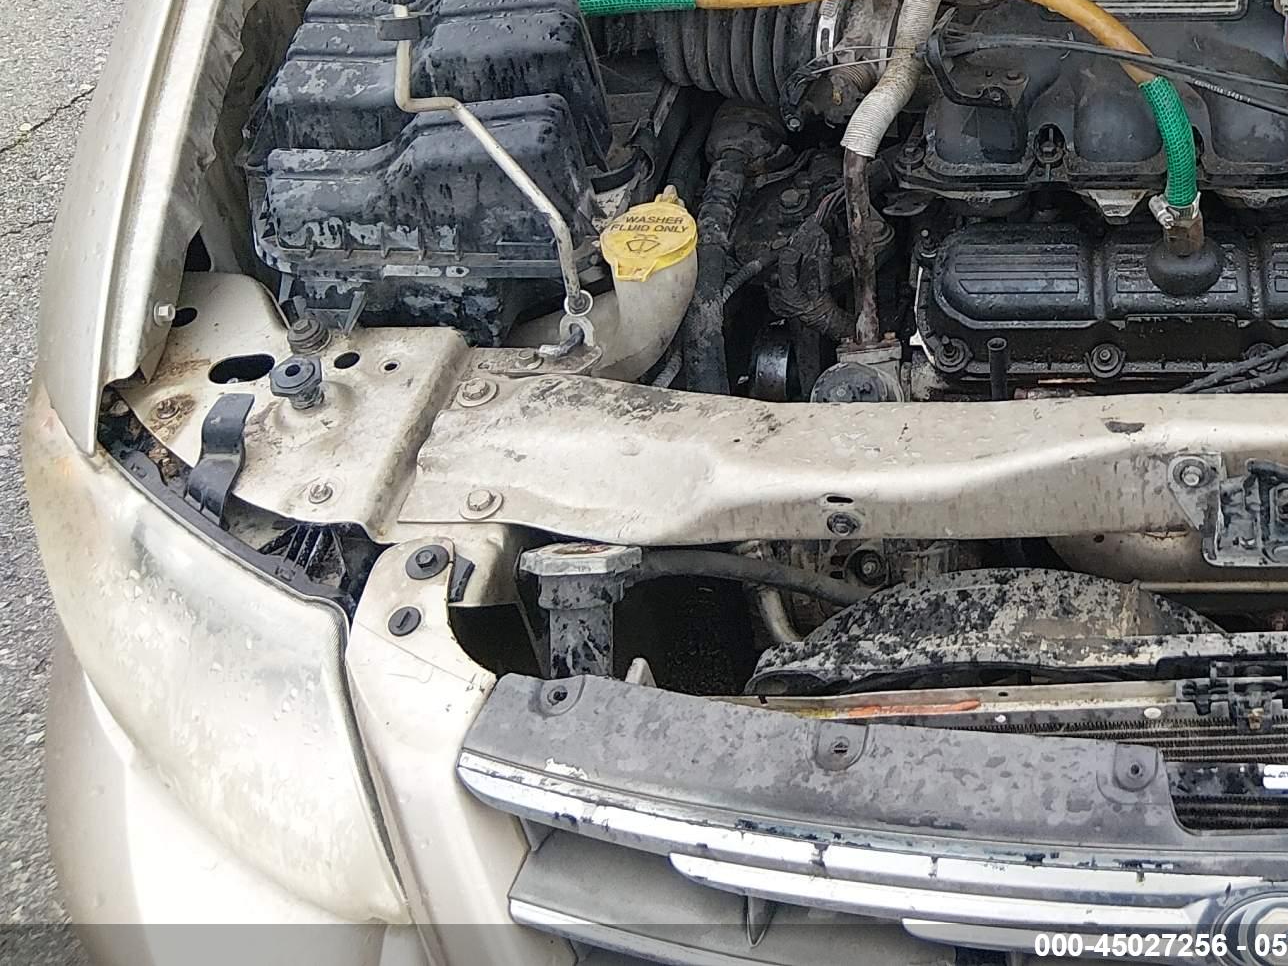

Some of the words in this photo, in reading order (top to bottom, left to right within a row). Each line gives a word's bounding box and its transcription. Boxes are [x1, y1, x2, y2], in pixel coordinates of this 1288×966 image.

[625, 216, 684, 224] WASHER
[610, 224, 650, 232] FLUID
[654, 224, 689, 233] ONLY
